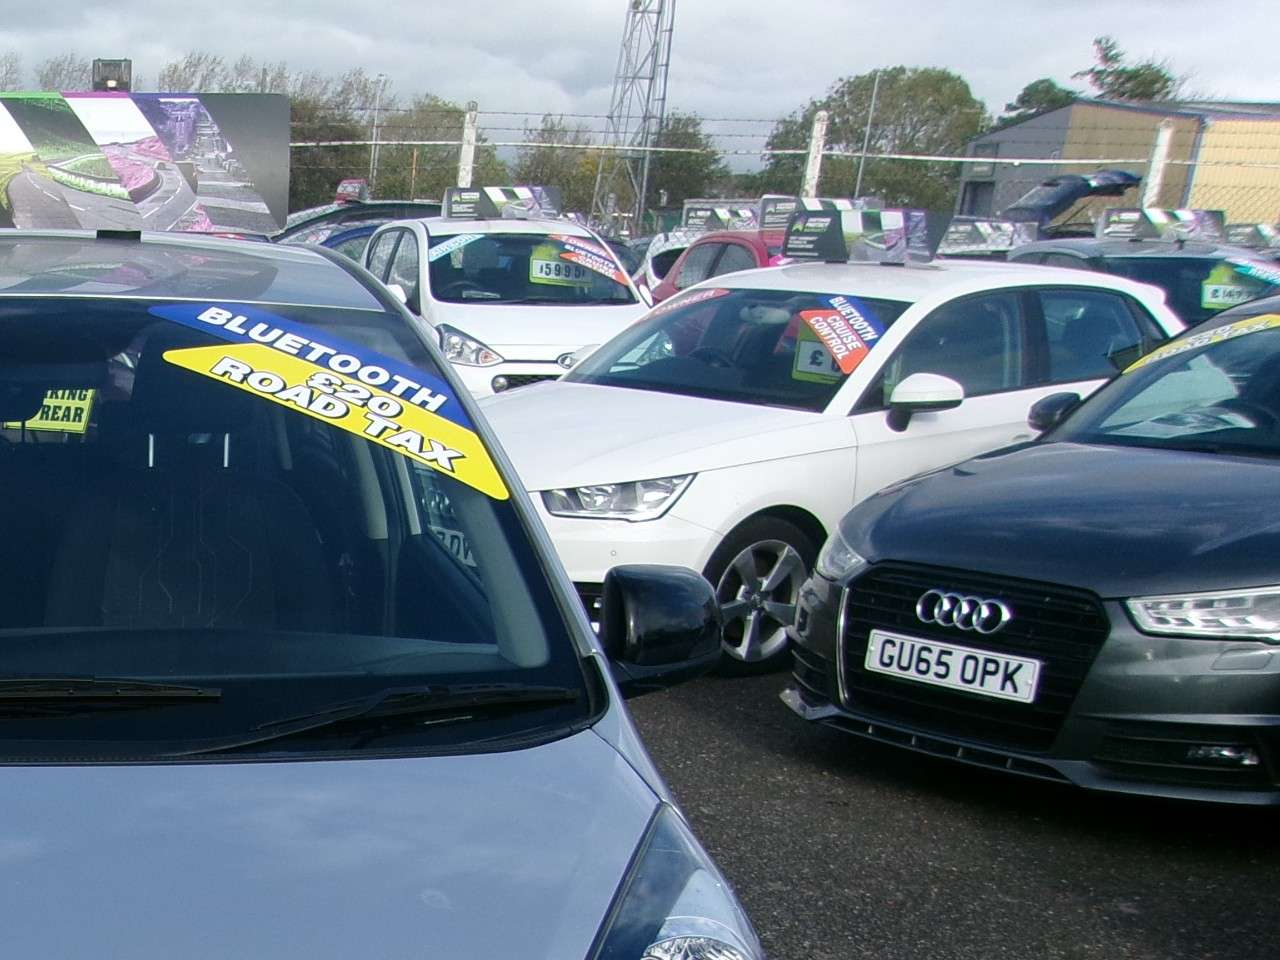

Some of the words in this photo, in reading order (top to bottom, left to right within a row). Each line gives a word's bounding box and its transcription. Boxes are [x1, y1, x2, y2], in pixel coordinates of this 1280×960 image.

[810, 316, 850, 360] CONTROL
[827, 315, 862, 351] CRUISE
[828, 296, 879, 341] BLUETOOTH
[196, 306, 448, 414] BLUETOOTH
[39, 404, 84, 422] REAR
[209, 356, 350, 419] ROAD
[362, 412, 466, 473] TAX
[305, 372, 404, 419] £20
[879, 638, 954, 680] GU65
[959, 653, 1024, 695] OPK
